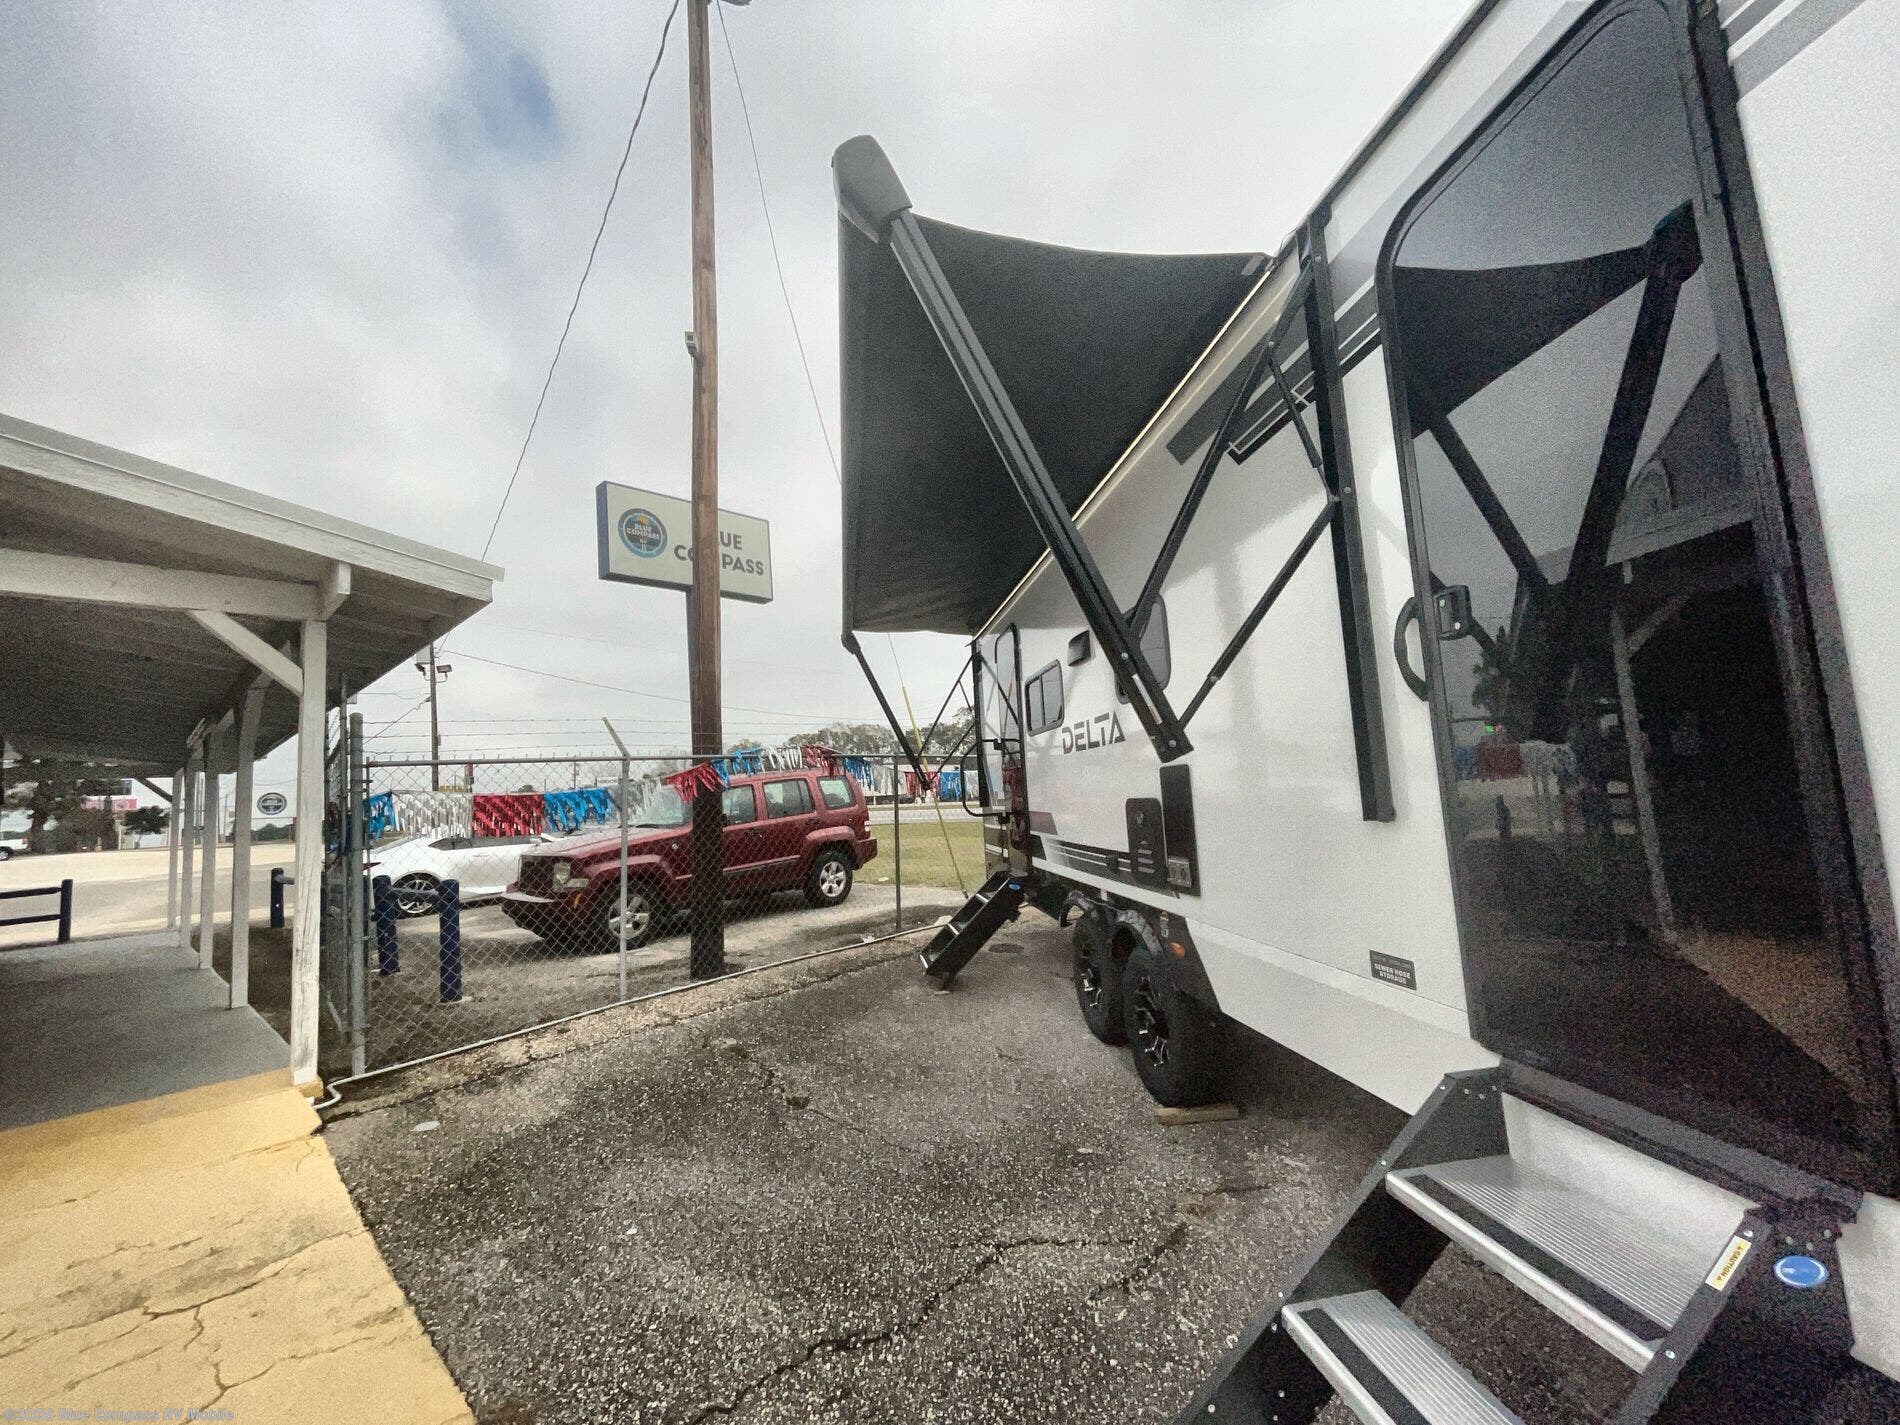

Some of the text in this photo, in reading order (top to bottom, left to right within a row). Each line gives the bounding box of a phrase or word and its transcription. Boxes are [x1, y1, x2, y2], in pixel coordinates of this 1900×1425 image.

[719, 531, 743, 550] UE
[673, 544, 764, 576] CPASS
[1061, 710, 1126, 755] DELTA
[1720, 1250, 1741, 1277] CAUTION
